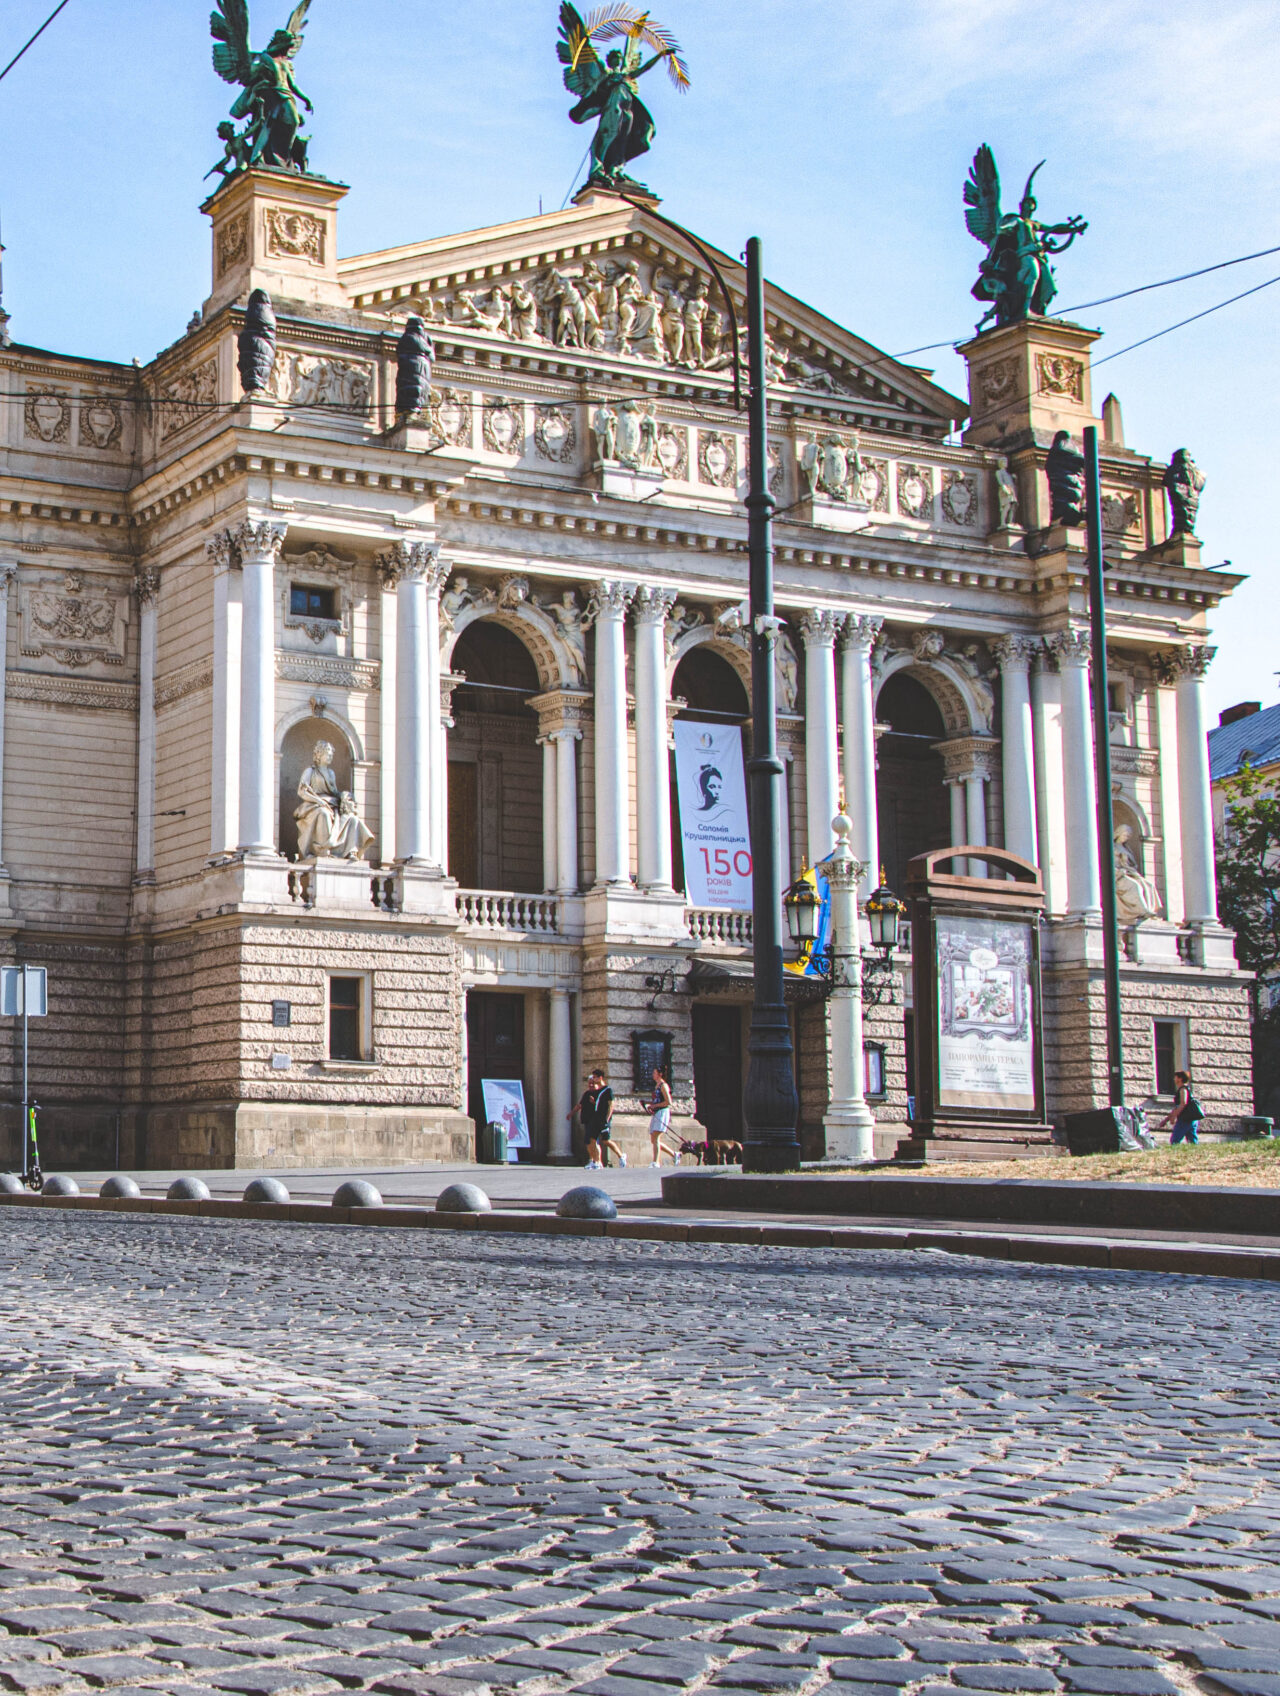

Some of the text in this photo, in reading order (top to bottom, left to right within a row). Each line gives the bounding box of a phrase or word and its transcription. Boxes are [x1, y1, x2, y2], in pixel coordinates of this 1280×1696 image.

[697, 823, 729, 833] Соломія
[684, 831, 746, 844] Крушельницька
[699, 847, 753, 878] 150
[706, 877, 732, 887] років
